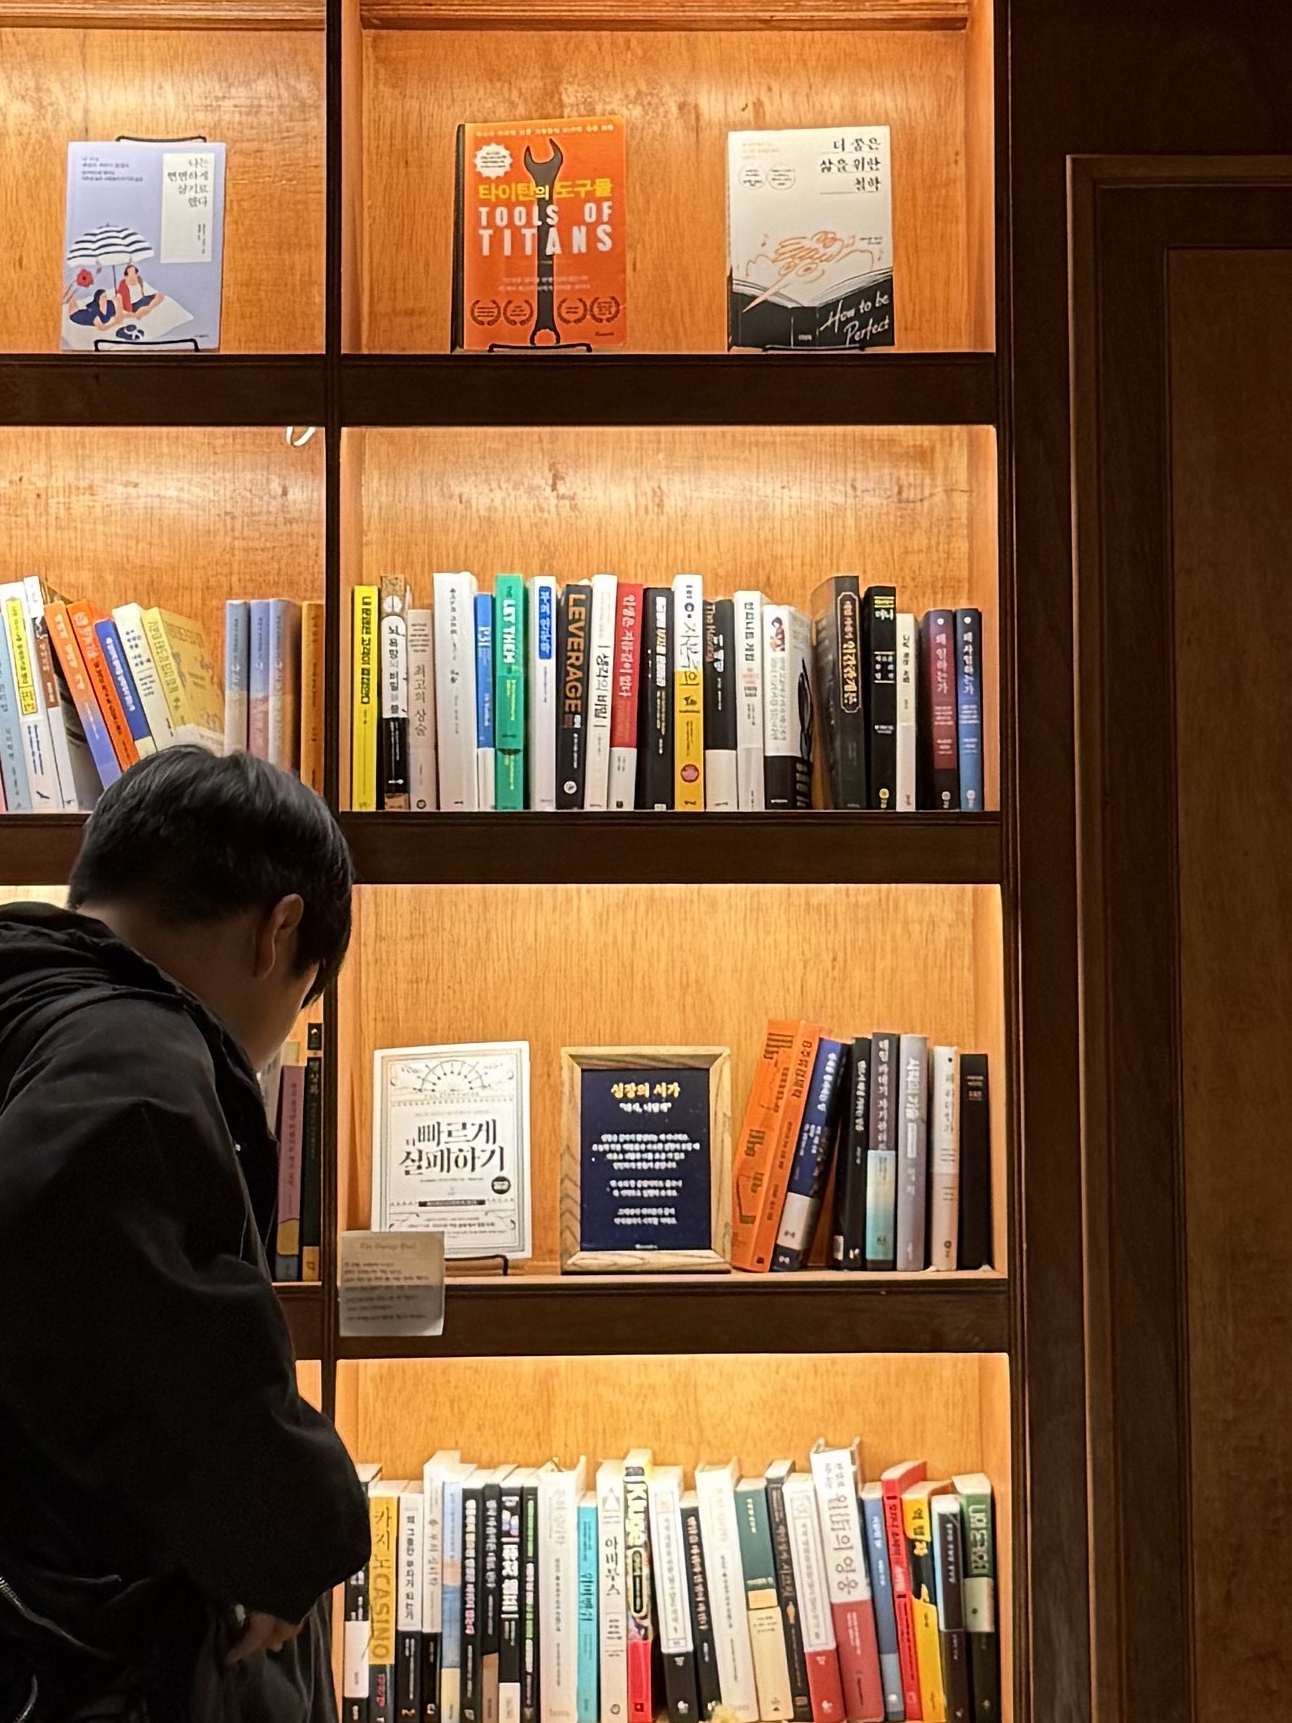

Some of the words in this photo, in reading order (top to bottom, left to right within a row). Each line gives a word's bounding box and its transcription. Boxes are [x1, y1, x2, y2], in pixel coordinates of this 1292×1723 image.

[478, 182, 550, 202] 타이탄의
[555, 178, 613, 199] 도구들
[478, 204, 559, 227] TOOLS
[584, 201, 613, 223] OF
[478, 224, 613, 257] TITANS
[819, 299, 855, 333] How
[858, 297, 873, 314] to
[875, 290, 890, 307] be
[843, 317, 890, 346] Perfect
[503, 599, 516, 623] LET
[503, 625, 516, 663] THEM
[565, 593, 587, 714] LEVERAGE
[413, 664, 427, 704] 최고의
[596, 653, 609, 692] 생각의
[594, 694, 607, 720] 비밀
[417, 1118, 497, 1148] 빠르게
[399, 1145, 504, 1176] 실패하기
[374, 1506, 393, 1570] 카지노
[371, 1573, 391, 1660] CASINO
